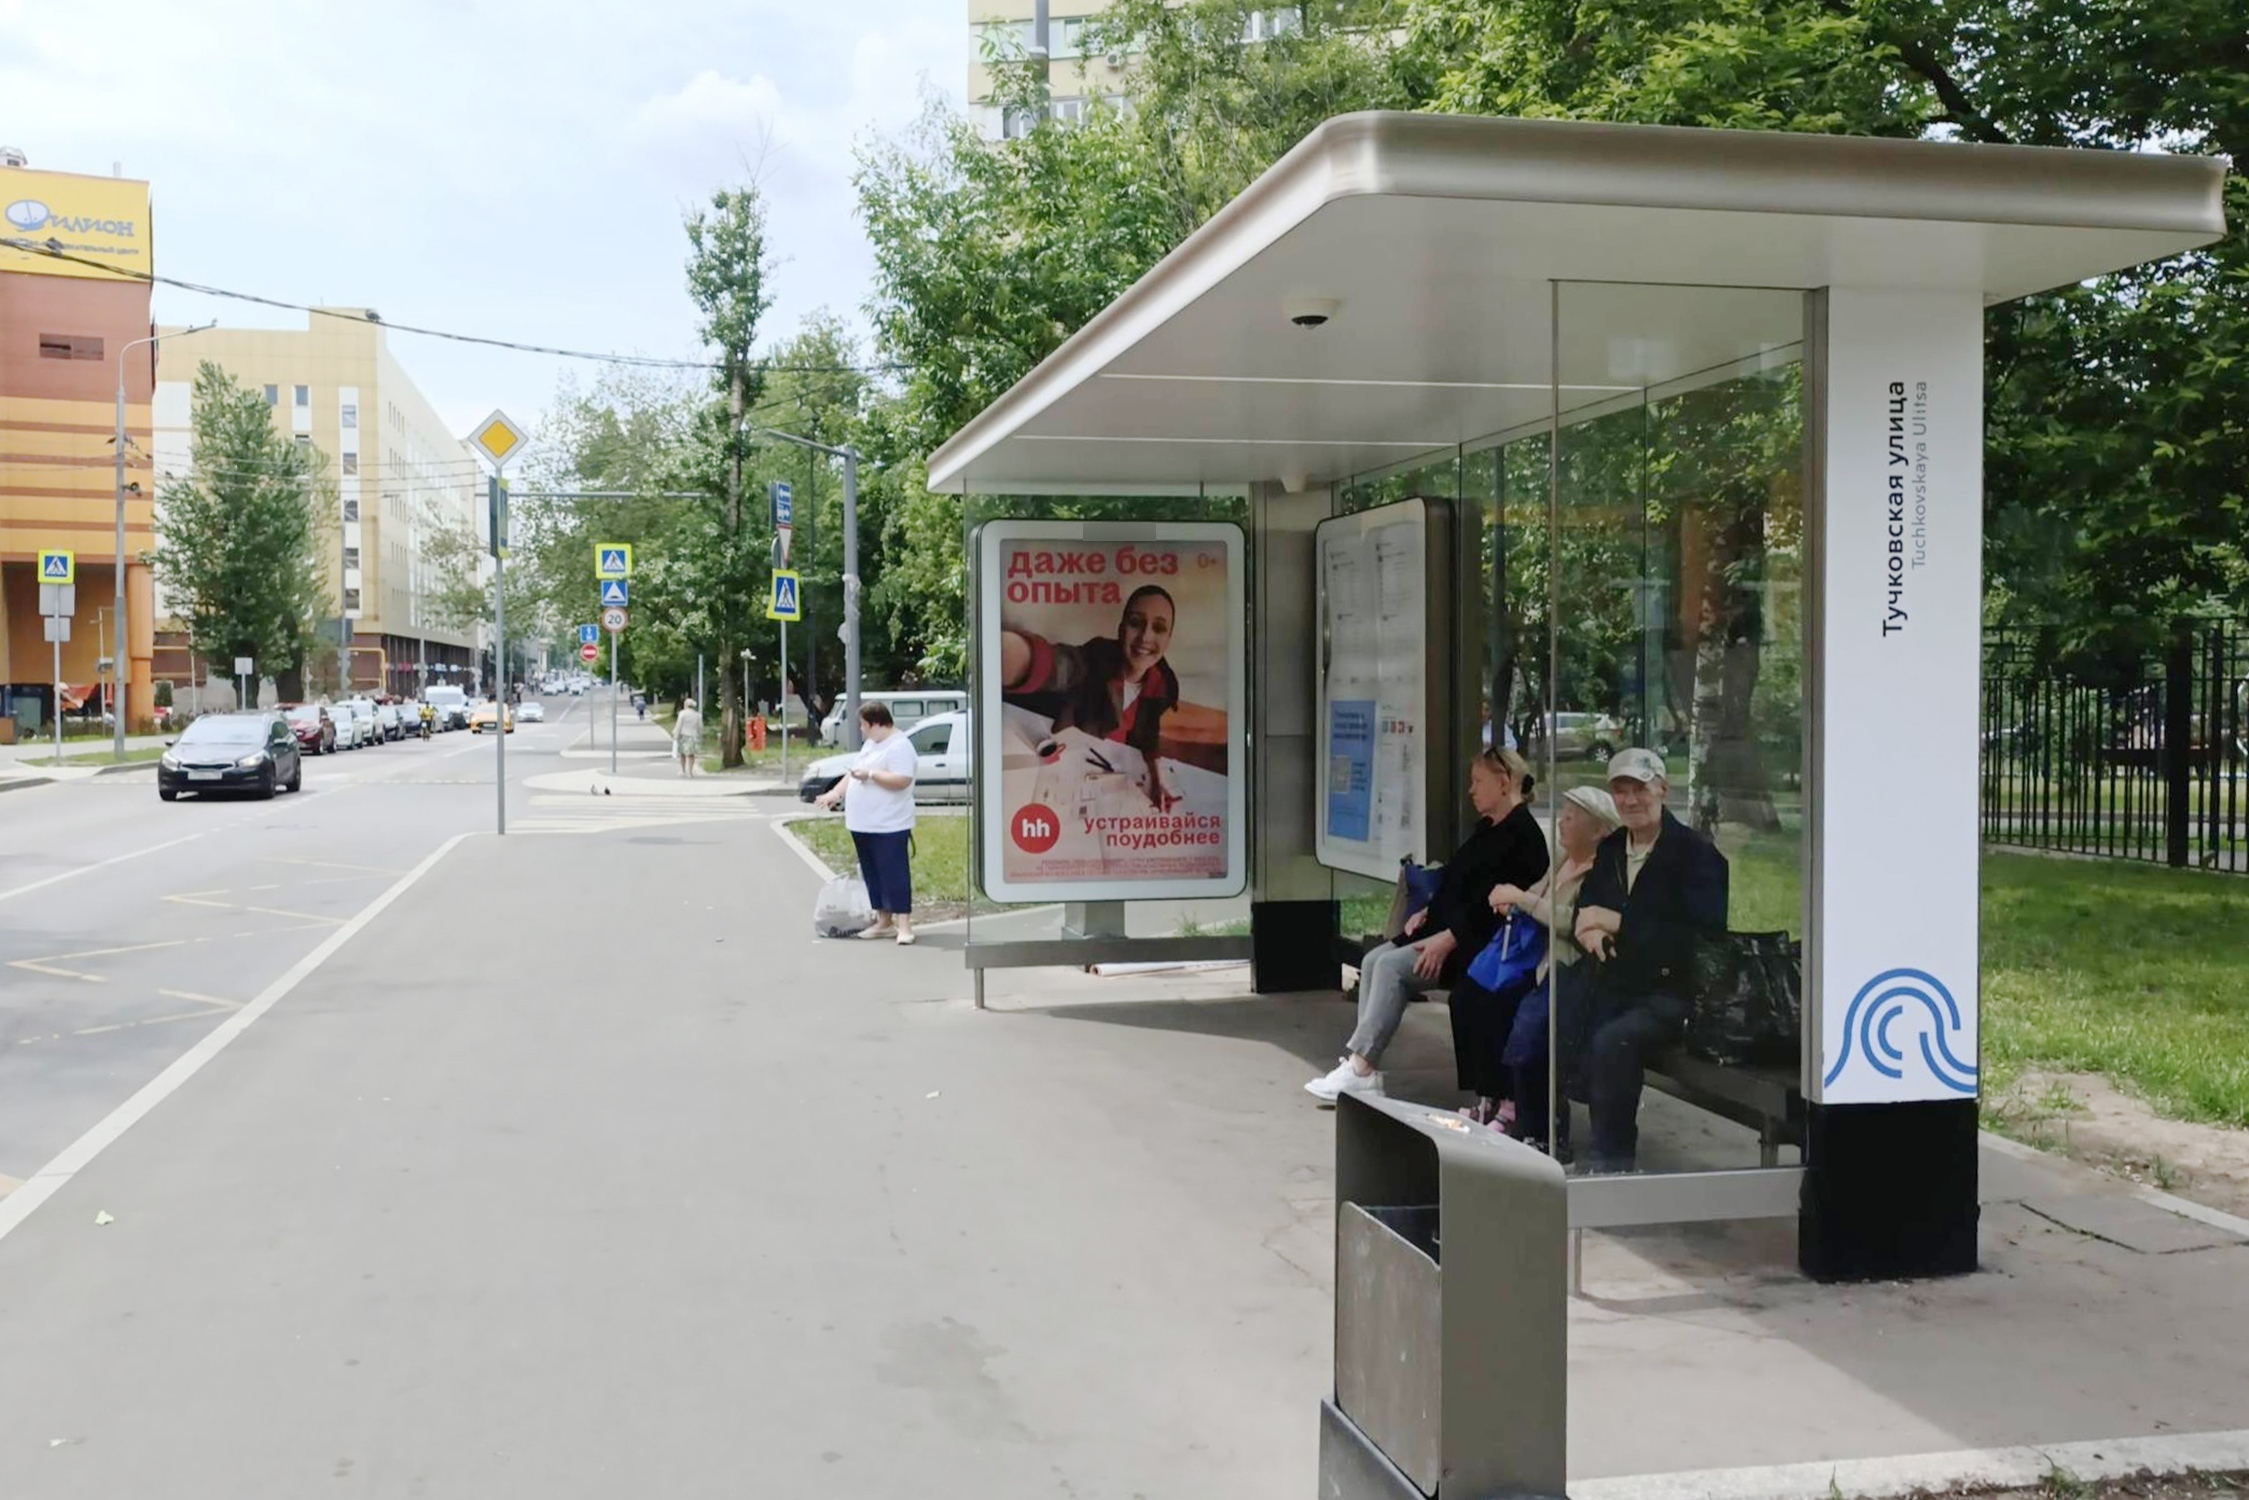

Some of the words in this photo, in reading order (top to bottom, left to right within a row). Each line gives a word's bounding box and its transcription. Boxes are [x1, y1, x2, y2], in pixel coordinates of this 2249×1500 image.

[1912, 381, 1928, 436] Ulitsa
[1888, 381, 1909, 467] улица
[1911, 442, 1930, 570] Tuchkovskaya
[1007, 551, 1106, 578] даже
[1115, 546, 1178, 575] без
[1883, 475, 1908, 637] Тучковская
[1007, 580, 1122, 604] опыта
[608, 614, 622, 625] 20
[1022, 818, 1050, 838] hh
[1084, 812, 1221, 834] устраивайся
[1106, 830, 1220, 849] поудобнее
